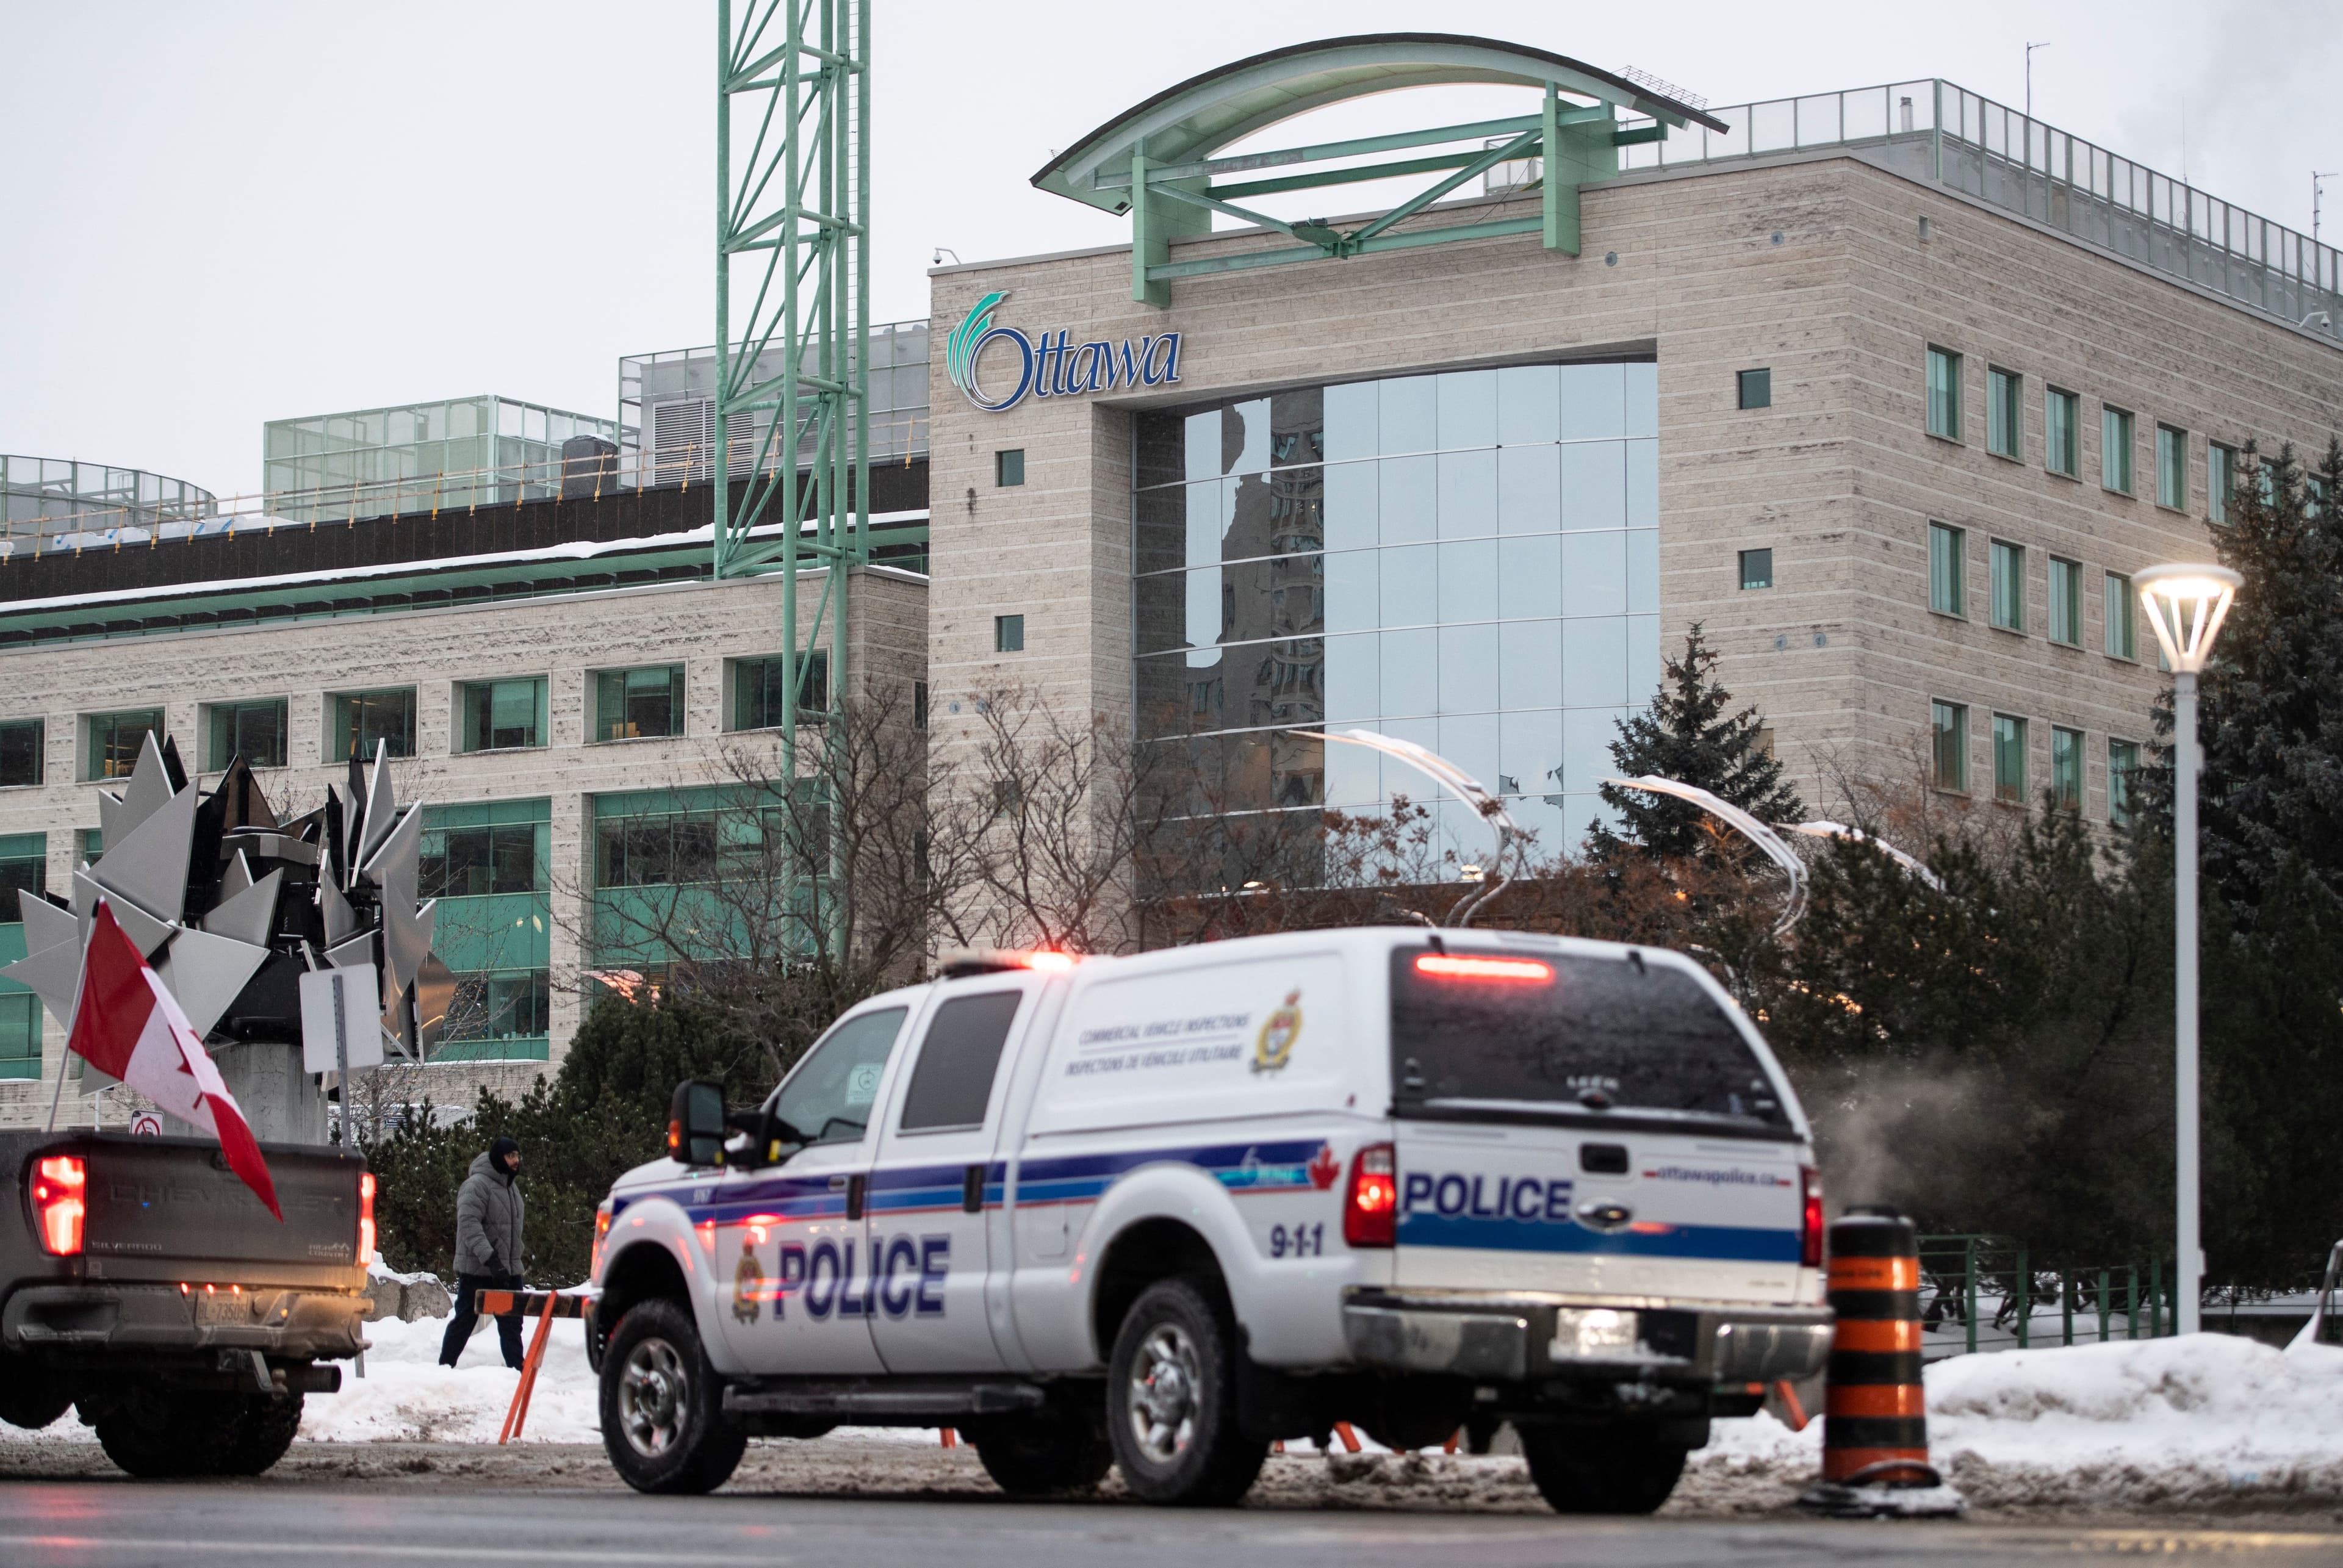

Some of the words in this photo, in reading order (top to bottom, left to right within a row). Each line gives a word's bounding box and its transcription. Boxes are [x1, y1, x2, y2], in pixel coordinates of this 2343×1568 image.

[969, 328, 1182, 412] Ottawa
[1078, 1024, 1140, 1046] COMMERCIAL
[1142, 1019, 1182, 1036] VEHICLE
[1186, 1012, 1250, 1032] INSPECTIONS
[1064, 1056, 1124, 1077] INSPECTIONS
[1125, 1054, 1139, 1069] DE
[1187, 1043, 1243, 1063] UTILITAIRE
[1658, 1166, 1777, 1187] ottawapolice.ca
[1402, 1171, 1574, 1222] POLICE
[91, 1240, 162, 1251] SILVERADO
[1271, 1222, 1324, 1258] 9-1-1
[772, 1232, 951, 1322] POLICE
